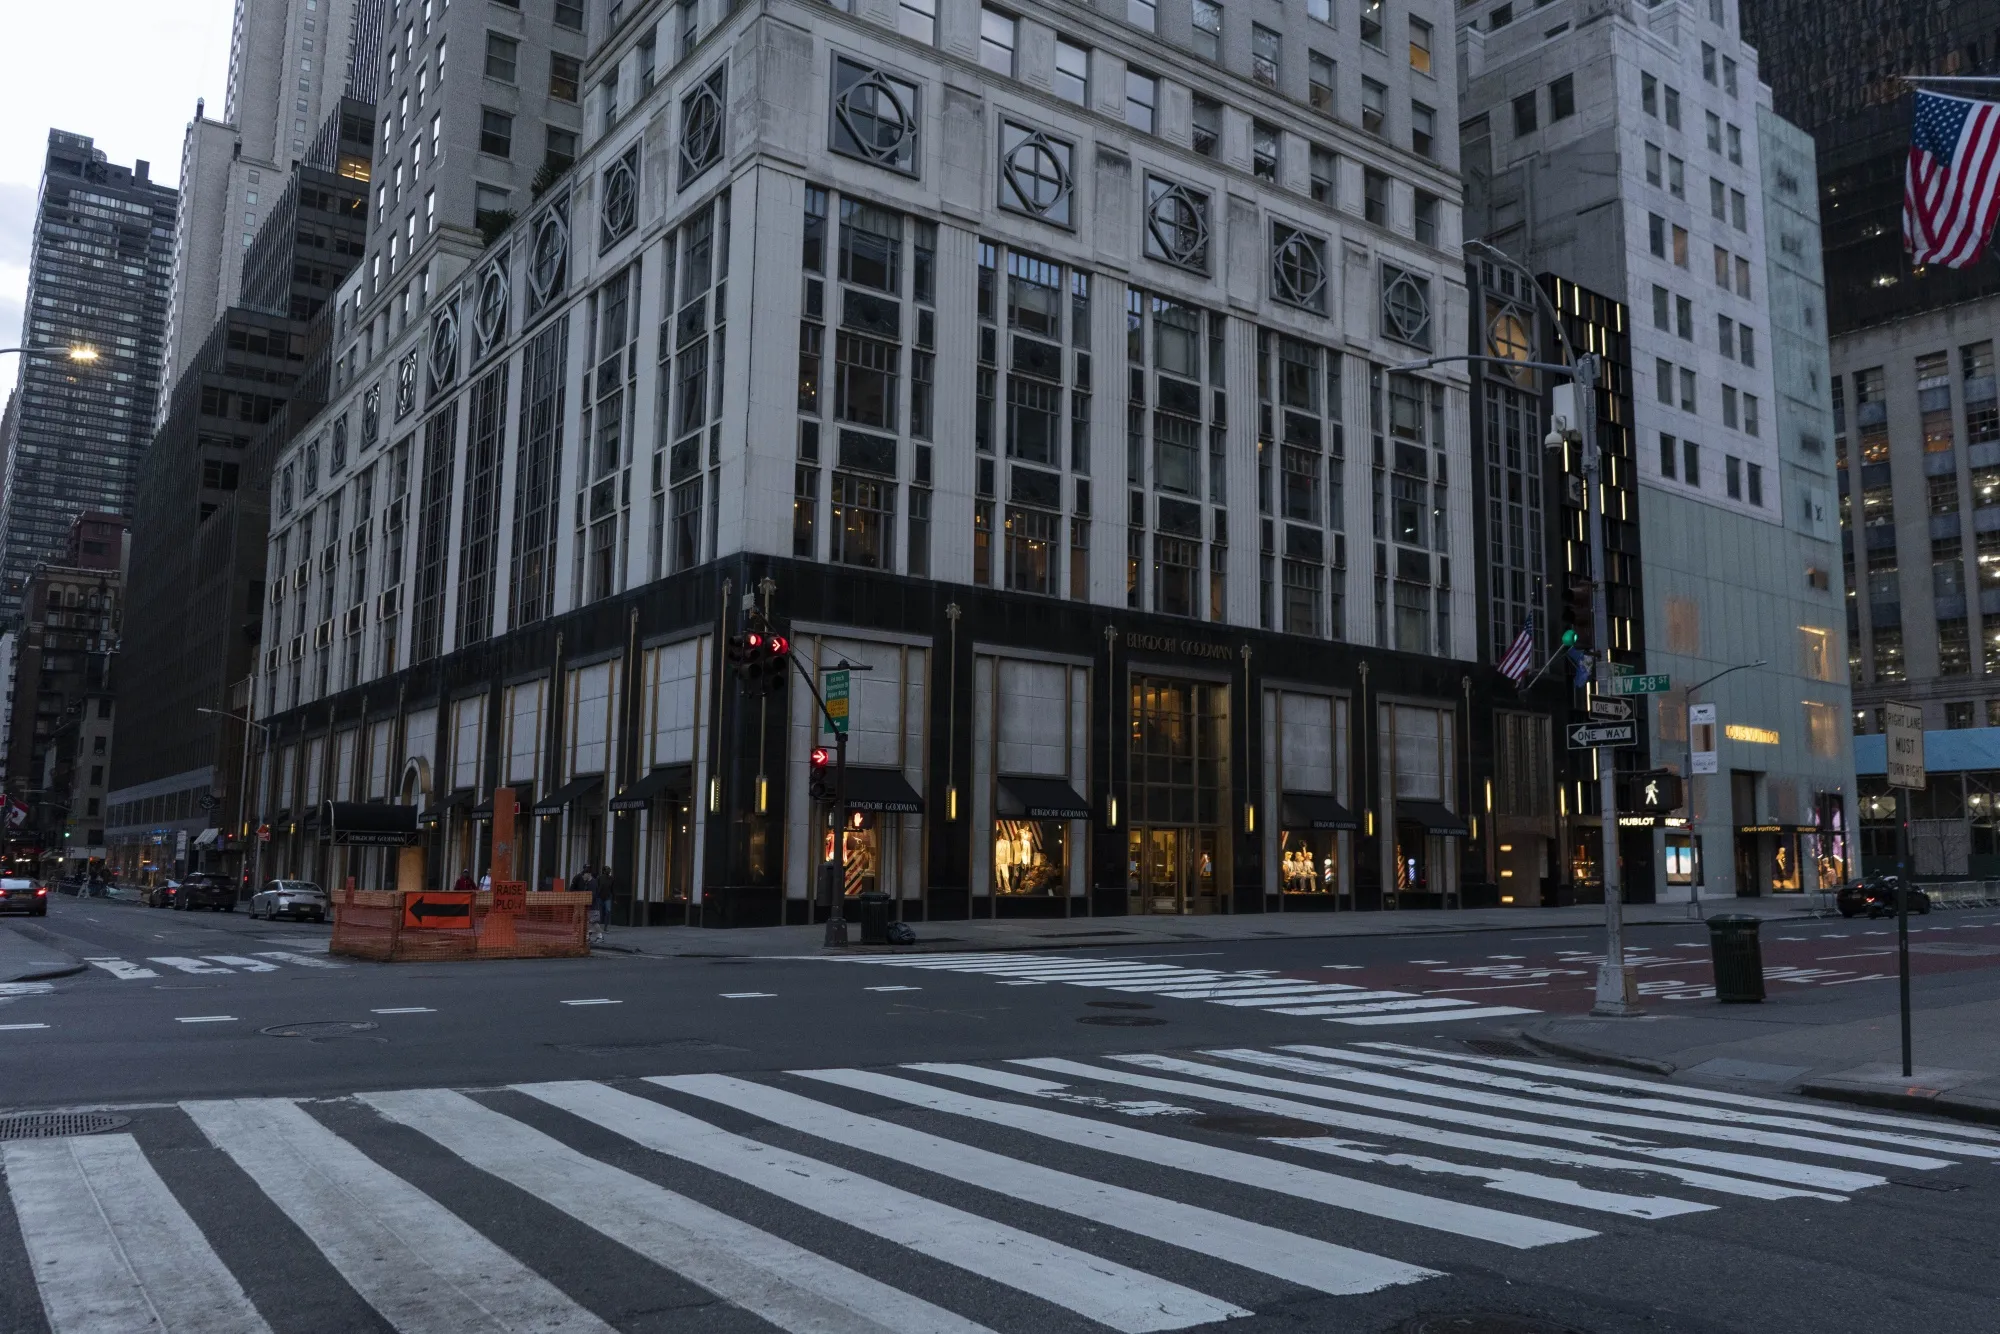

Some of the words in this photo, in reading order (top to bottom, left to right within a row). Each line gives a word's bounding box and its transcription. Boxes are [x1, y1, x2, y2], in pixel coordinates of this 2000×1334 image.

[1126, 632, 1177, 653] BERGDORF
[1180, 640, 1233, 660] GOODMAN
[1623, 679, 1634, 693] W
[1639, 676, 1657, 692] 58
[1658, 676, 1668, 685] ST
[1595, 702, 1609, 712] ONE
[1614, 706, 1628, 715] WAY
[1887, 712, 1905, 727] RIGHT
[1906, 715, 1922, 730] LANE
[1577, 730, 1597, 741] ONE
[1604, 728, 1627, 739] WAY
[1895, 737, 1914, 755] MUST
[1889, 761, 1905, 777] TURN
[1905, 764, 1923, 779] RIGHT
[850, 800, 884, 810] BERGDORF
[885, 803, 918, 812] GOODMAN
[1619, 817, 1655, 826] HUBLOT
[496, 884, 523, 896] RAISE
